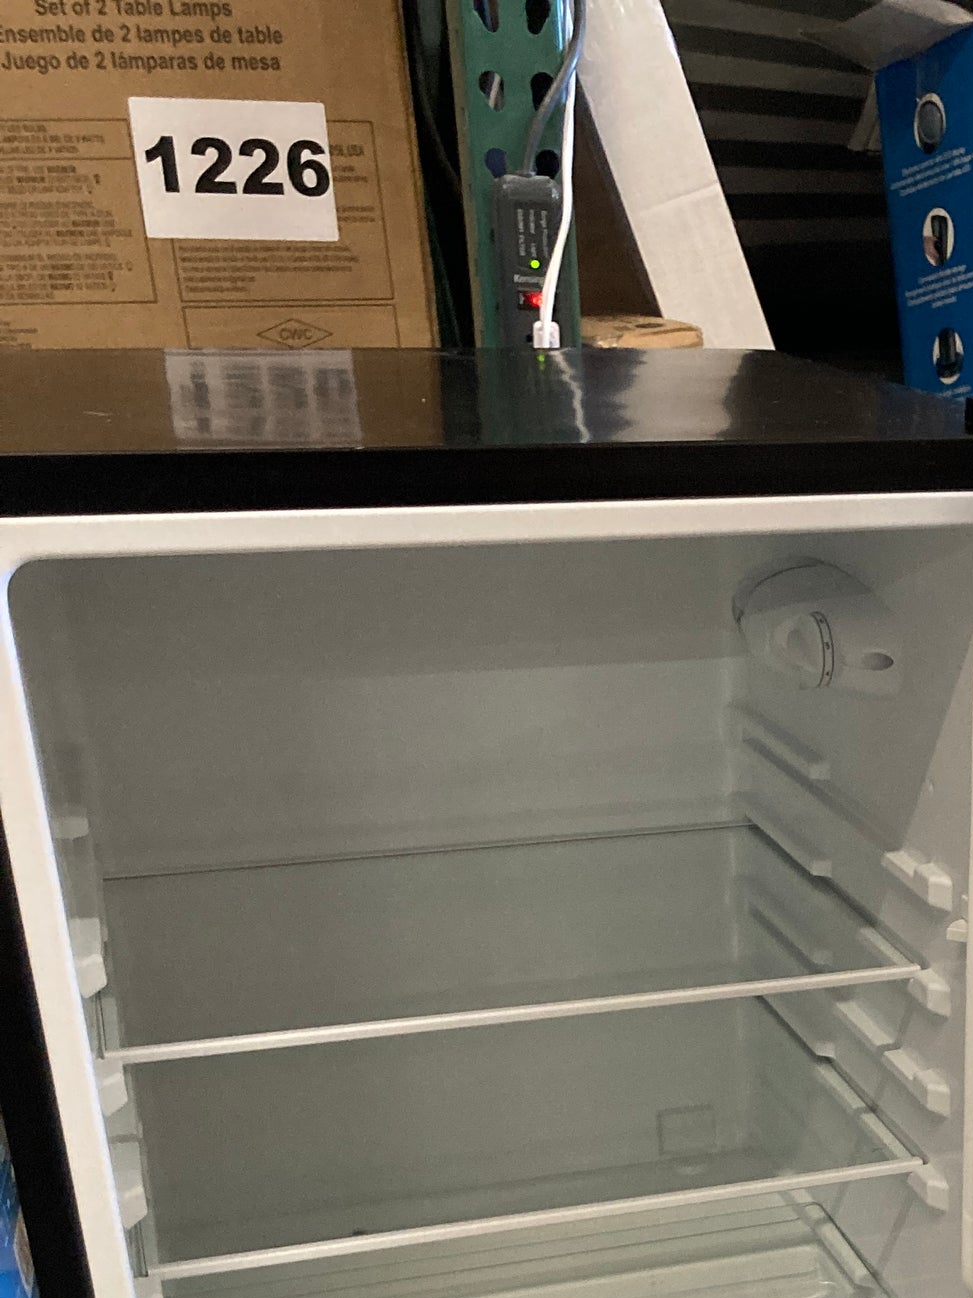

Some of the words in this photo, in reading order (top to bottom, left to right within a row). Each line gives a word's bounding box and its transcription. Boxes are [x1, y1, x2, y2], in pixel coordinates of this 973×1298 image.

[35, 0, 66, 16] Set
[72, 0, 91, 16] of
[98, 0, 108, 16] 2
[114, 0, 162, 16] Table
[169, 0, 232, 20] Lamps
[92, 24, 114, 43] de
[119, 24, 131, 42] 2
[136, 24, 204, 48] lampes
[210, 26, 232, 44] de
[238, 25, 283, 44] table
[2, 51, 60, 74] Juego
[66, 51, 90, 70] de
[94, 51, 107, 70] 2
[111, 51, 198, 74] lámparas
[204, 51, 225, 70] de
[231, 56, 280, 70] mesa
[144, 136, 330, 197] 1226
